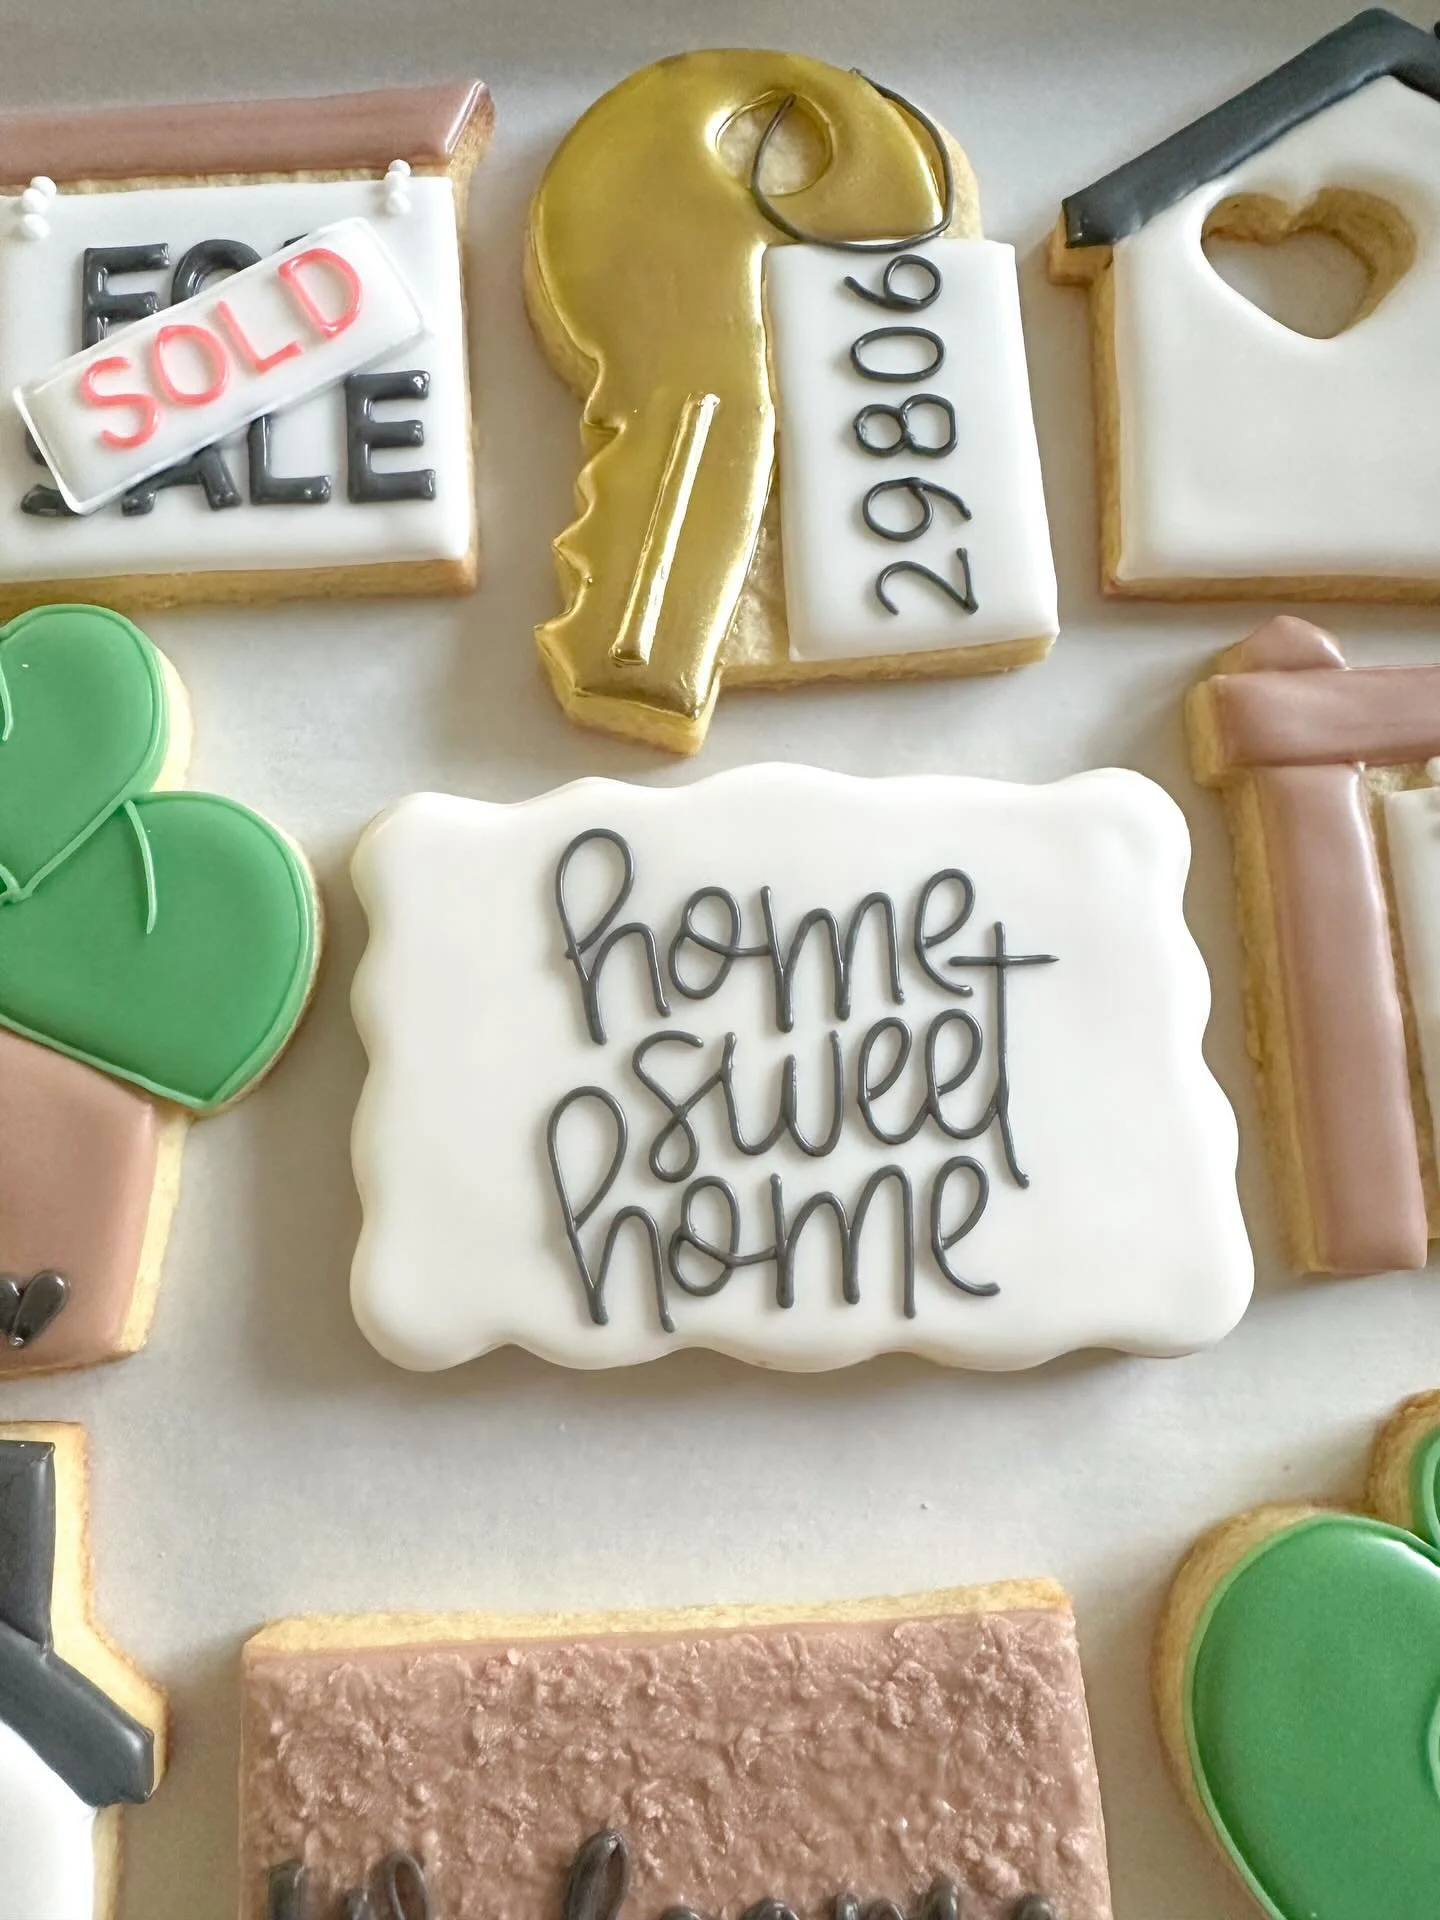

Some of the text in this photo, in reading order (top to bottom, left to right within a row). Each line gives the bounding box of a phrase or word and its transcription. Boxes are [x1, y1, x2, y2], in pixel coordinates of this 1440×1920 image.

[80, 247, 364, 450] SOLD
[843, 253, 980, 617] 29806
[554, 827, 976, 1045] home
[632, 921, 1060, 1189] sweet
[547, 1085, 1001, 1333] home
